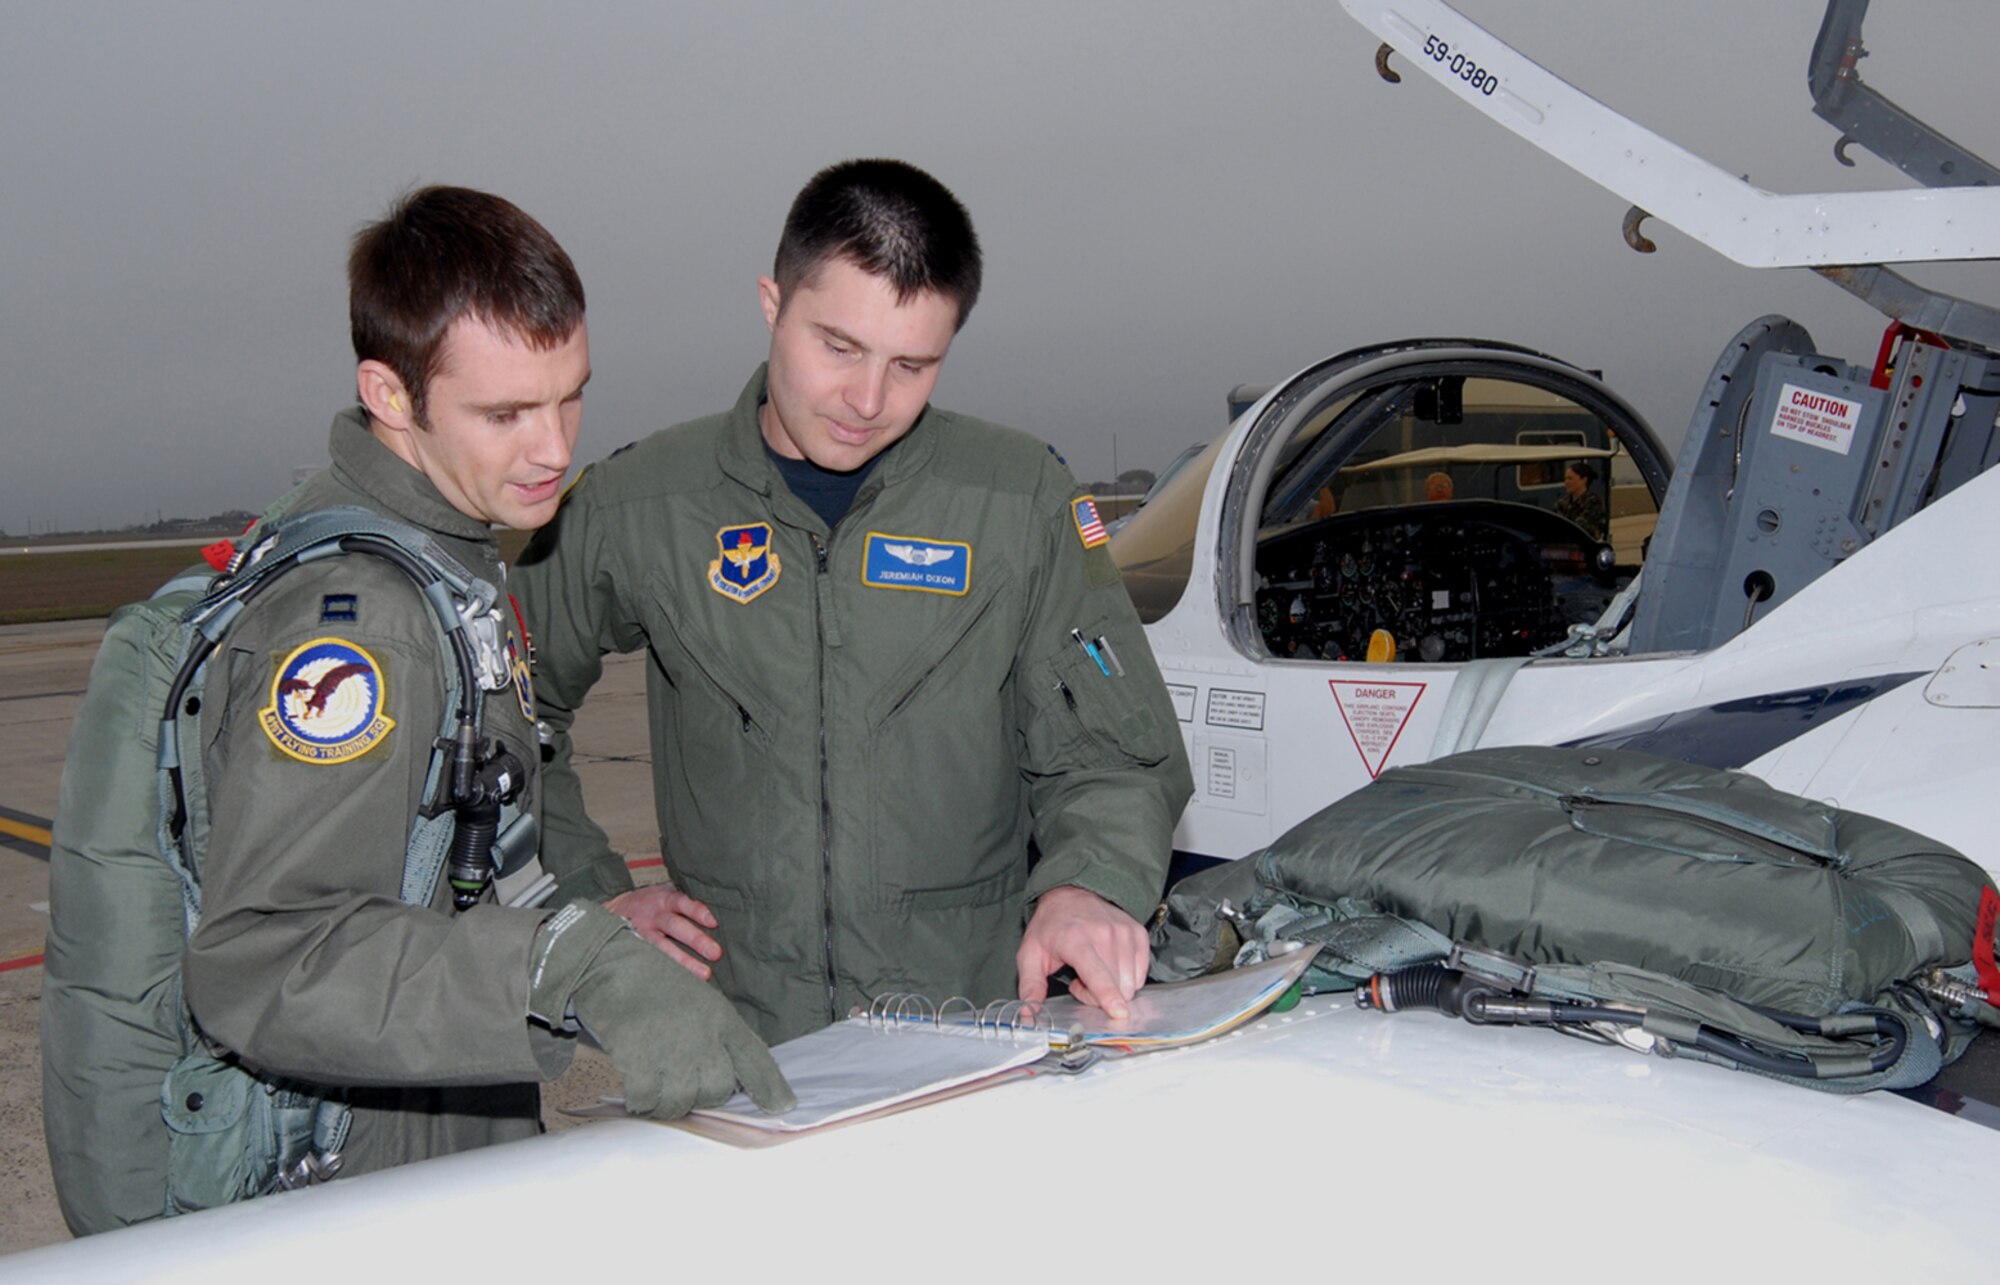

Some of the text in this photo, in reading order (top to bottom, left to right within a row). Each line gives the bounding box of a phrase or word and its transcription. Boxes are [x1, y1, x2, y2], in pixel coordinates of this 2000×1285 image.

[1423, 34, 1498, 96] 59-0380
[1791, 391, 1849, 418] CAUTION
[1778, 413, 1831, 432] HARNESS BUCKLES
[1786, 422, 1797, 430] TOP
[1790, 407, 1801, 415] NOT
[1802, 411, 1819, 420] STOW
[1821, 416, 1851, 430] SHOULDER
[879, 570, 956, 585] JEREMIAH DIXON
[1355, 688, 1396, 699] DANGER
[281, 735, 318, 757] FLYING
[320, 737, 371, 758] TRAINING
[371, 719, 386, 737] SQ
